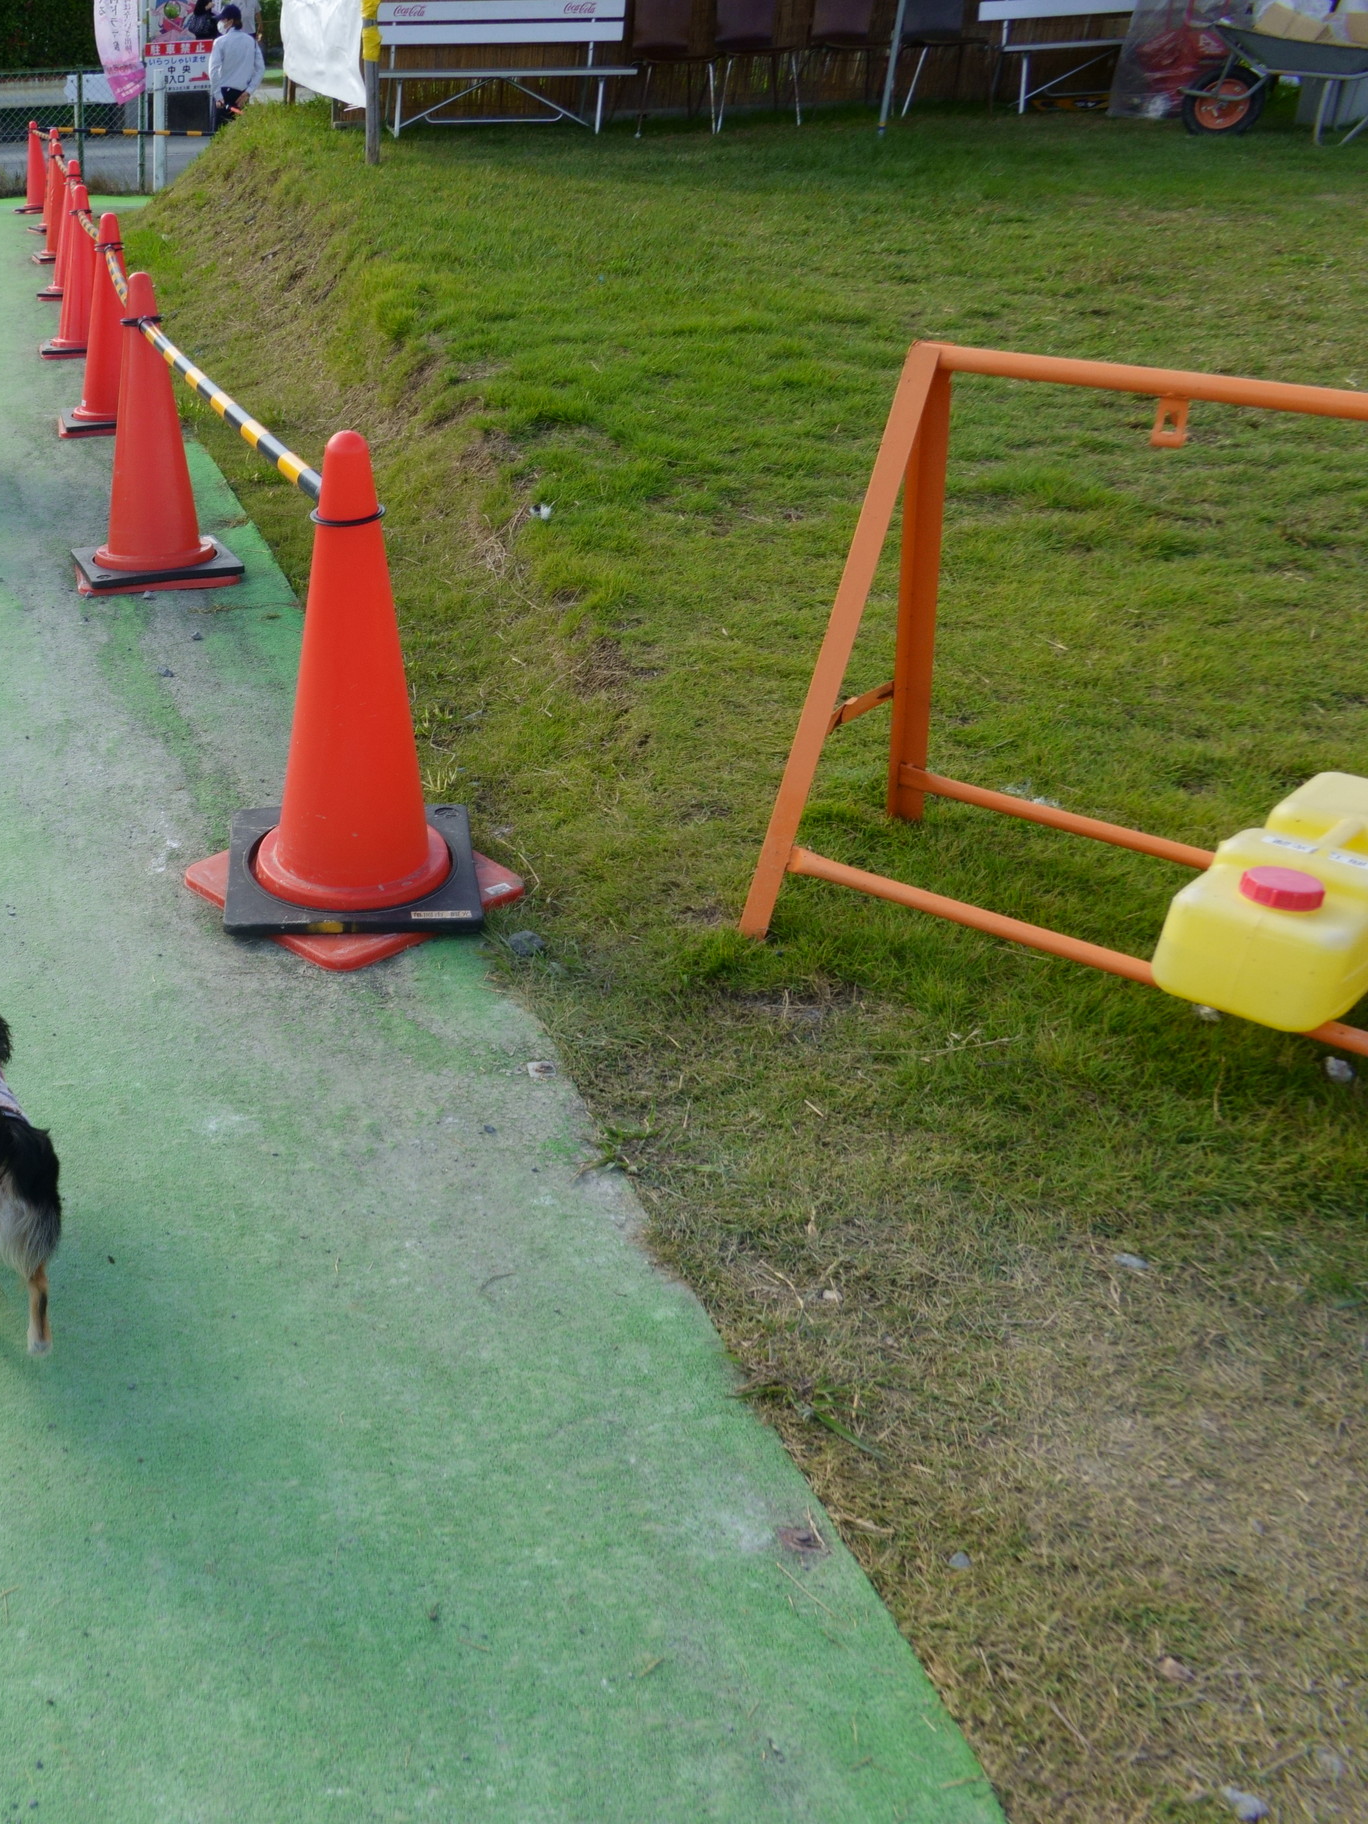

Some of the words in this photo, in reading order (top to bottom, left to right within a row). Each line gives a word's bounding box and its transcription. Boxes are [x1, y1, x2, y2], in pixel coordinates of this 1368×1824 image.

[149, 56, 206, 66] いらっしゃいませ
[168, 65, 191, 74] 中央
